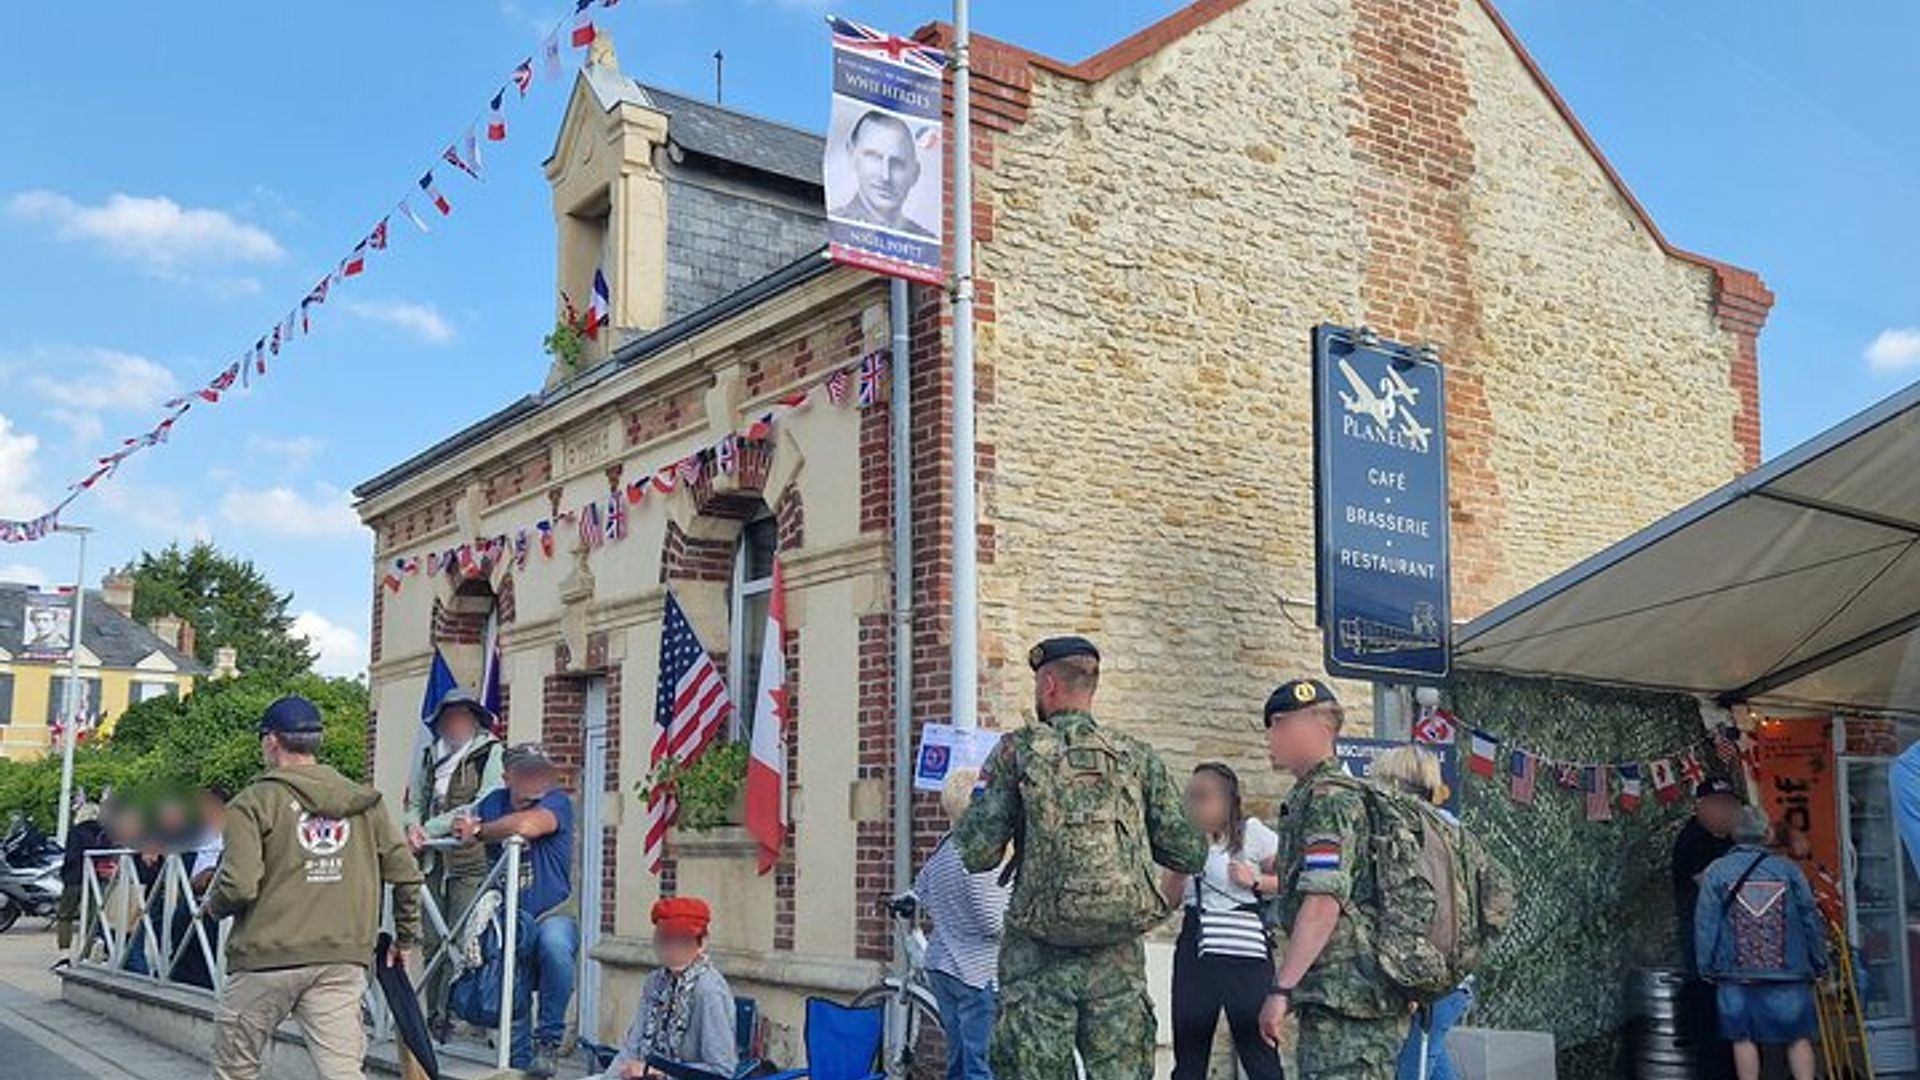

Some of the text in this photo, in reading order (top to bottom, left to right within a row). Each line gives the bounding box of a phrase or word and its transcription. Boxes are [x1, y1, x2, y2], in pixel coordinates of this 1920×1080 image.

[1368, 467, 1407, 491] CAFÉ
[1346, 505, 1430, 538] BRASSERIE
[1341, 548, 1435, 579] RESTAURANT
